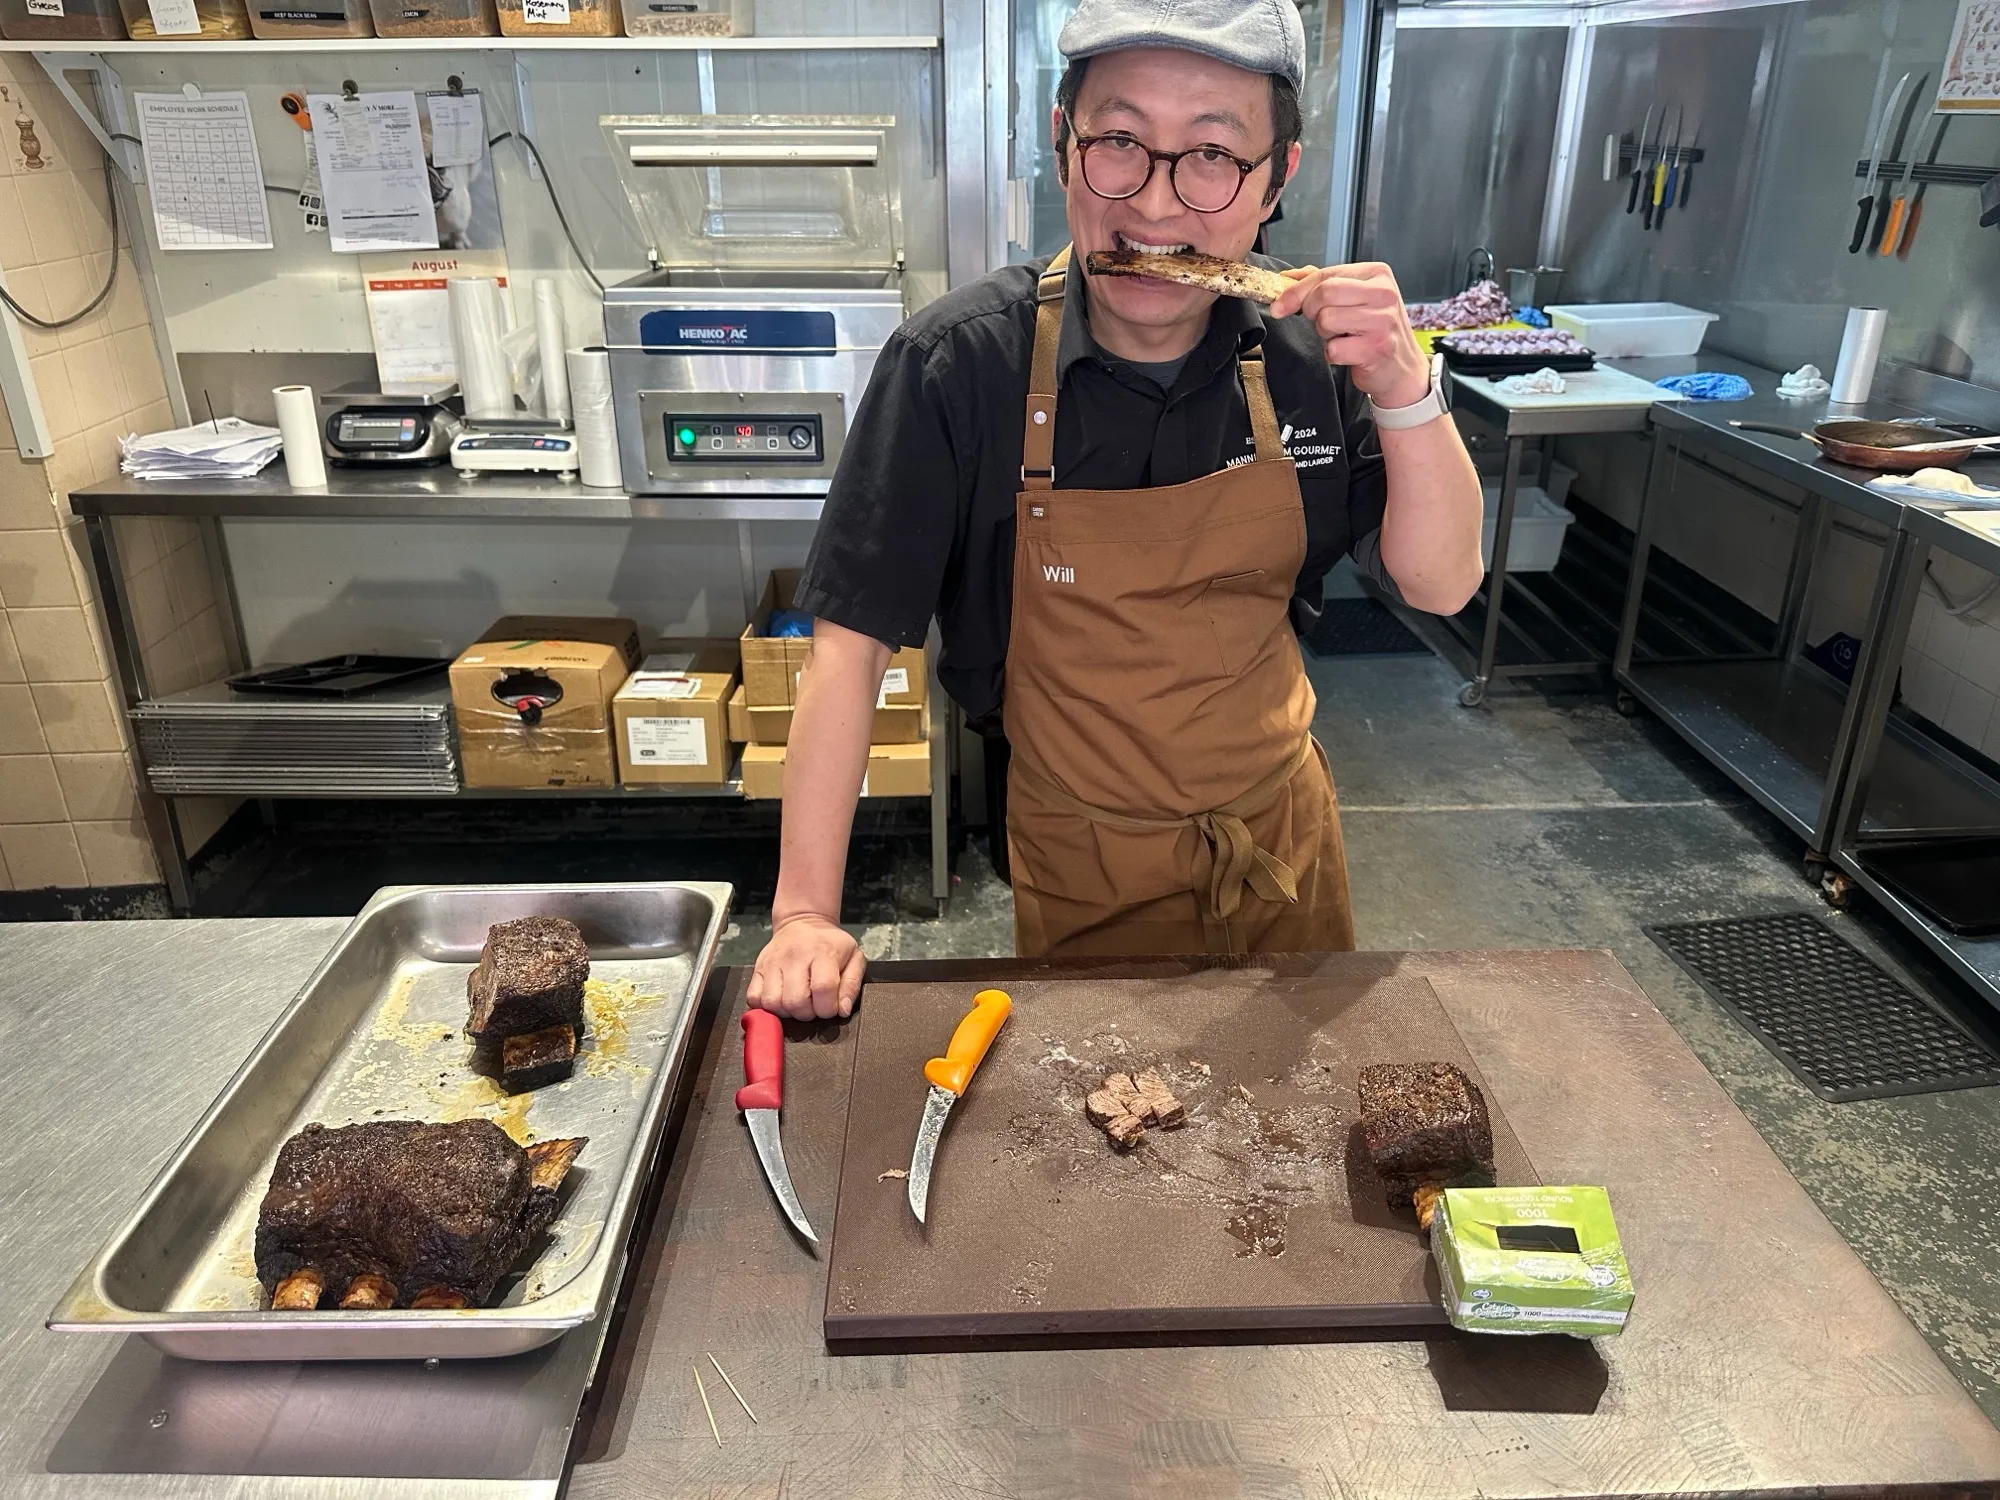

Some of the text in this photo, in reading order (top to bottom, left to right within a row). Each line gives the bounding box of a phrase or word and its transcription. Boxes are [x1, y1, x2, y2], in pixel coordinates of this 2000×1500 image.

[527, 8, 547, 19] Mint
[149, 105, 186, 114] EMPLOYEE
[207, 104, 239, 113] SCHEDULE
[412, 259, 458, 273] August
[679, 326, 747, 341] HENKOVAC
[738, 426, 752, 437] 40
[1294, 427, 1317, 439] 2024
[1293, 446, 1341, 455] GOURMET
[1295, 456, 1334, 468] AND LARDER
[1042, 565, 1075, 584] Will
[1516, 1208, 1549, 1218] 1000
